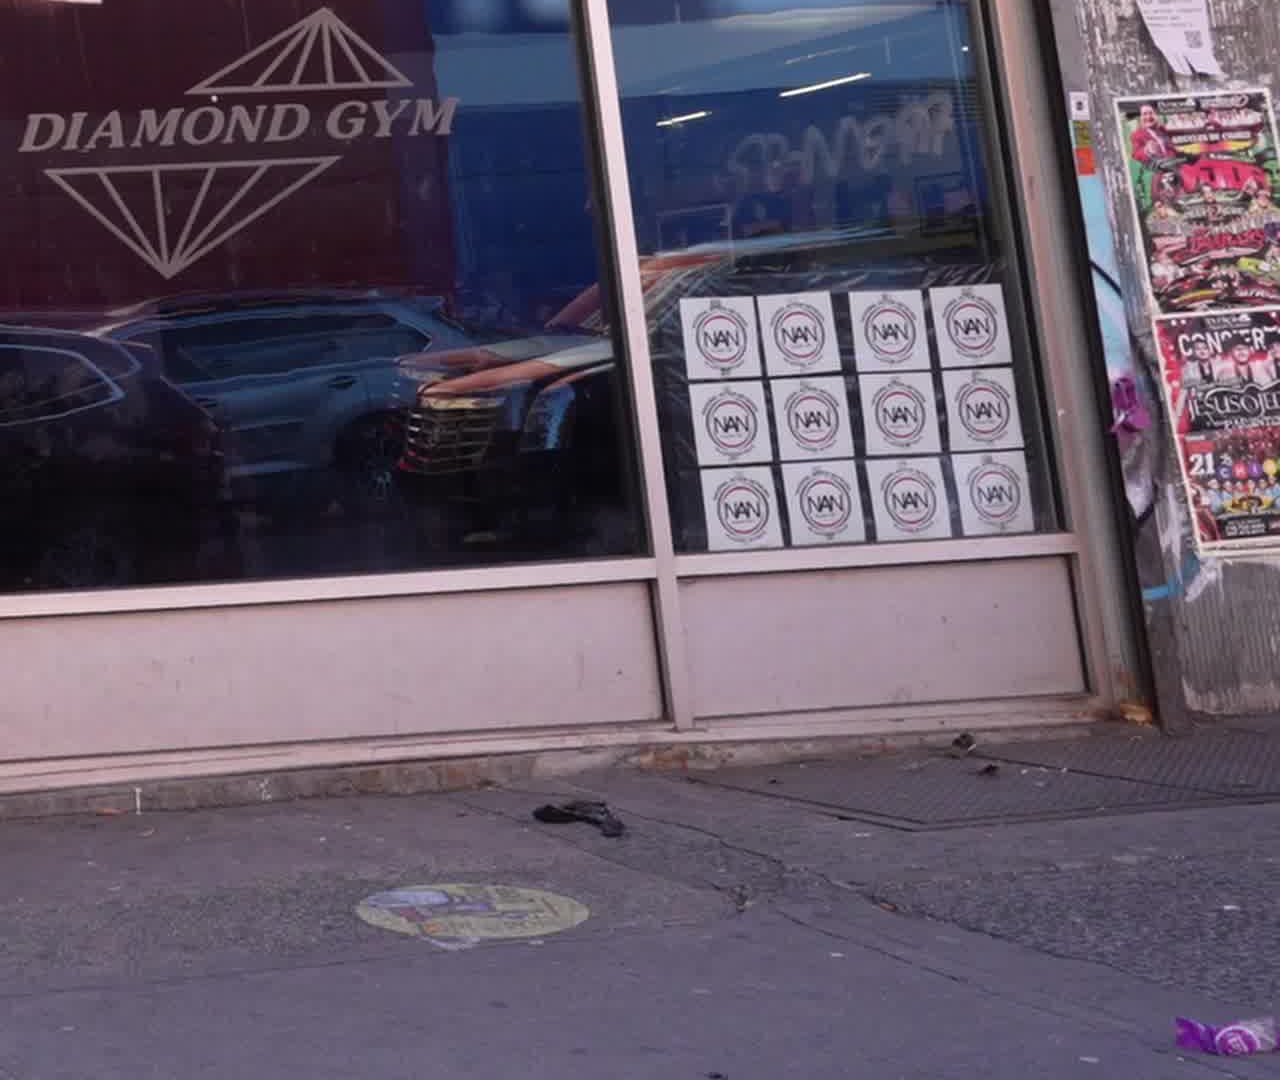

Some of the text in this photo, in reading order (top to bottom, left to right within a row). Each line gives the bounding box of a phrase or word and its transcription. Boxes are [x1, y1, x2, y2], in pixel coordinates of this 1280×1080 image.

[17, 96, 461, 154] DIAMOND GYM
[781, 325, 818, 344] NAN
[871, 322, 909, 341] NAN
[953, 317, 990, 336] NAN
[704, 330, 740, 347] NAN
[794, 411, 831, 429] NAN
[882, 405, 918, 424] NAN
[966, 401, 1002, 420] NAN
[713, 415, 749, 433] NAN
[1189, 451, 1216, 477] 21
[892, 491, 929, 510] NAN
[977, 485, 1013, 503] NAN
[724, 501, 761, 520] NAN
[807, 495, 843, 514] NAN
